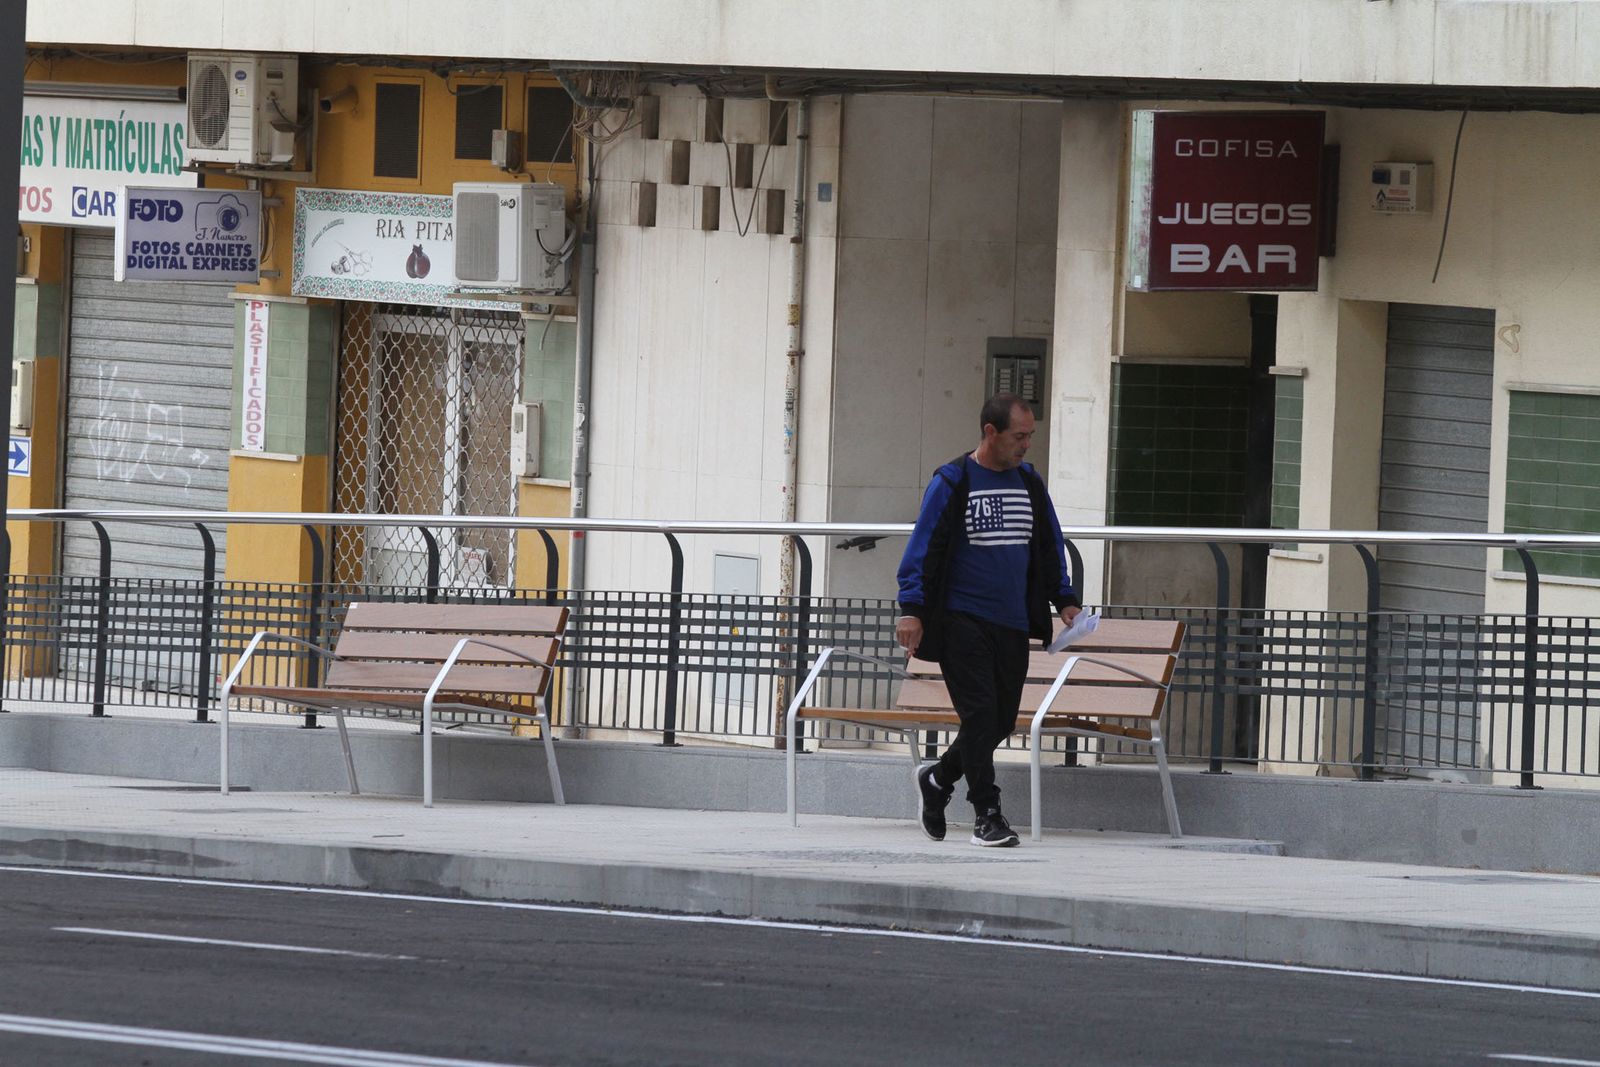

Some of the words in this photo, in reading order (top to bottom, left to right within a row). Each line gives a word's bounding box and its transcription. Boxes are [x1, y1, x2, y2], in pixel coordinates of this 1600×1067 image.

[49, 116, 61, 167] Y
[65, 109, 184, 176] MATRÍCULAS
[1175, 138, 1298, 158] COFISA
[129, 199, 184, 223] FOTO
[1158, 202, 1312, 226] JUEGOS
[376, 219, 405, 238] RIA
[416, 221, 453, 240] PITA
[132, 241, 180, 255] FOTOS
[185, 242, 252, 257] CARNETS
[1170, 243, 1297, 273] BAR
[127, 256, 187, 270] DIGITAL
[192, 257, 257, 271] EXPRESS
[246, 301, 264, 446] PLASTIFICADOS
[972, 498, 992, 518] 76
